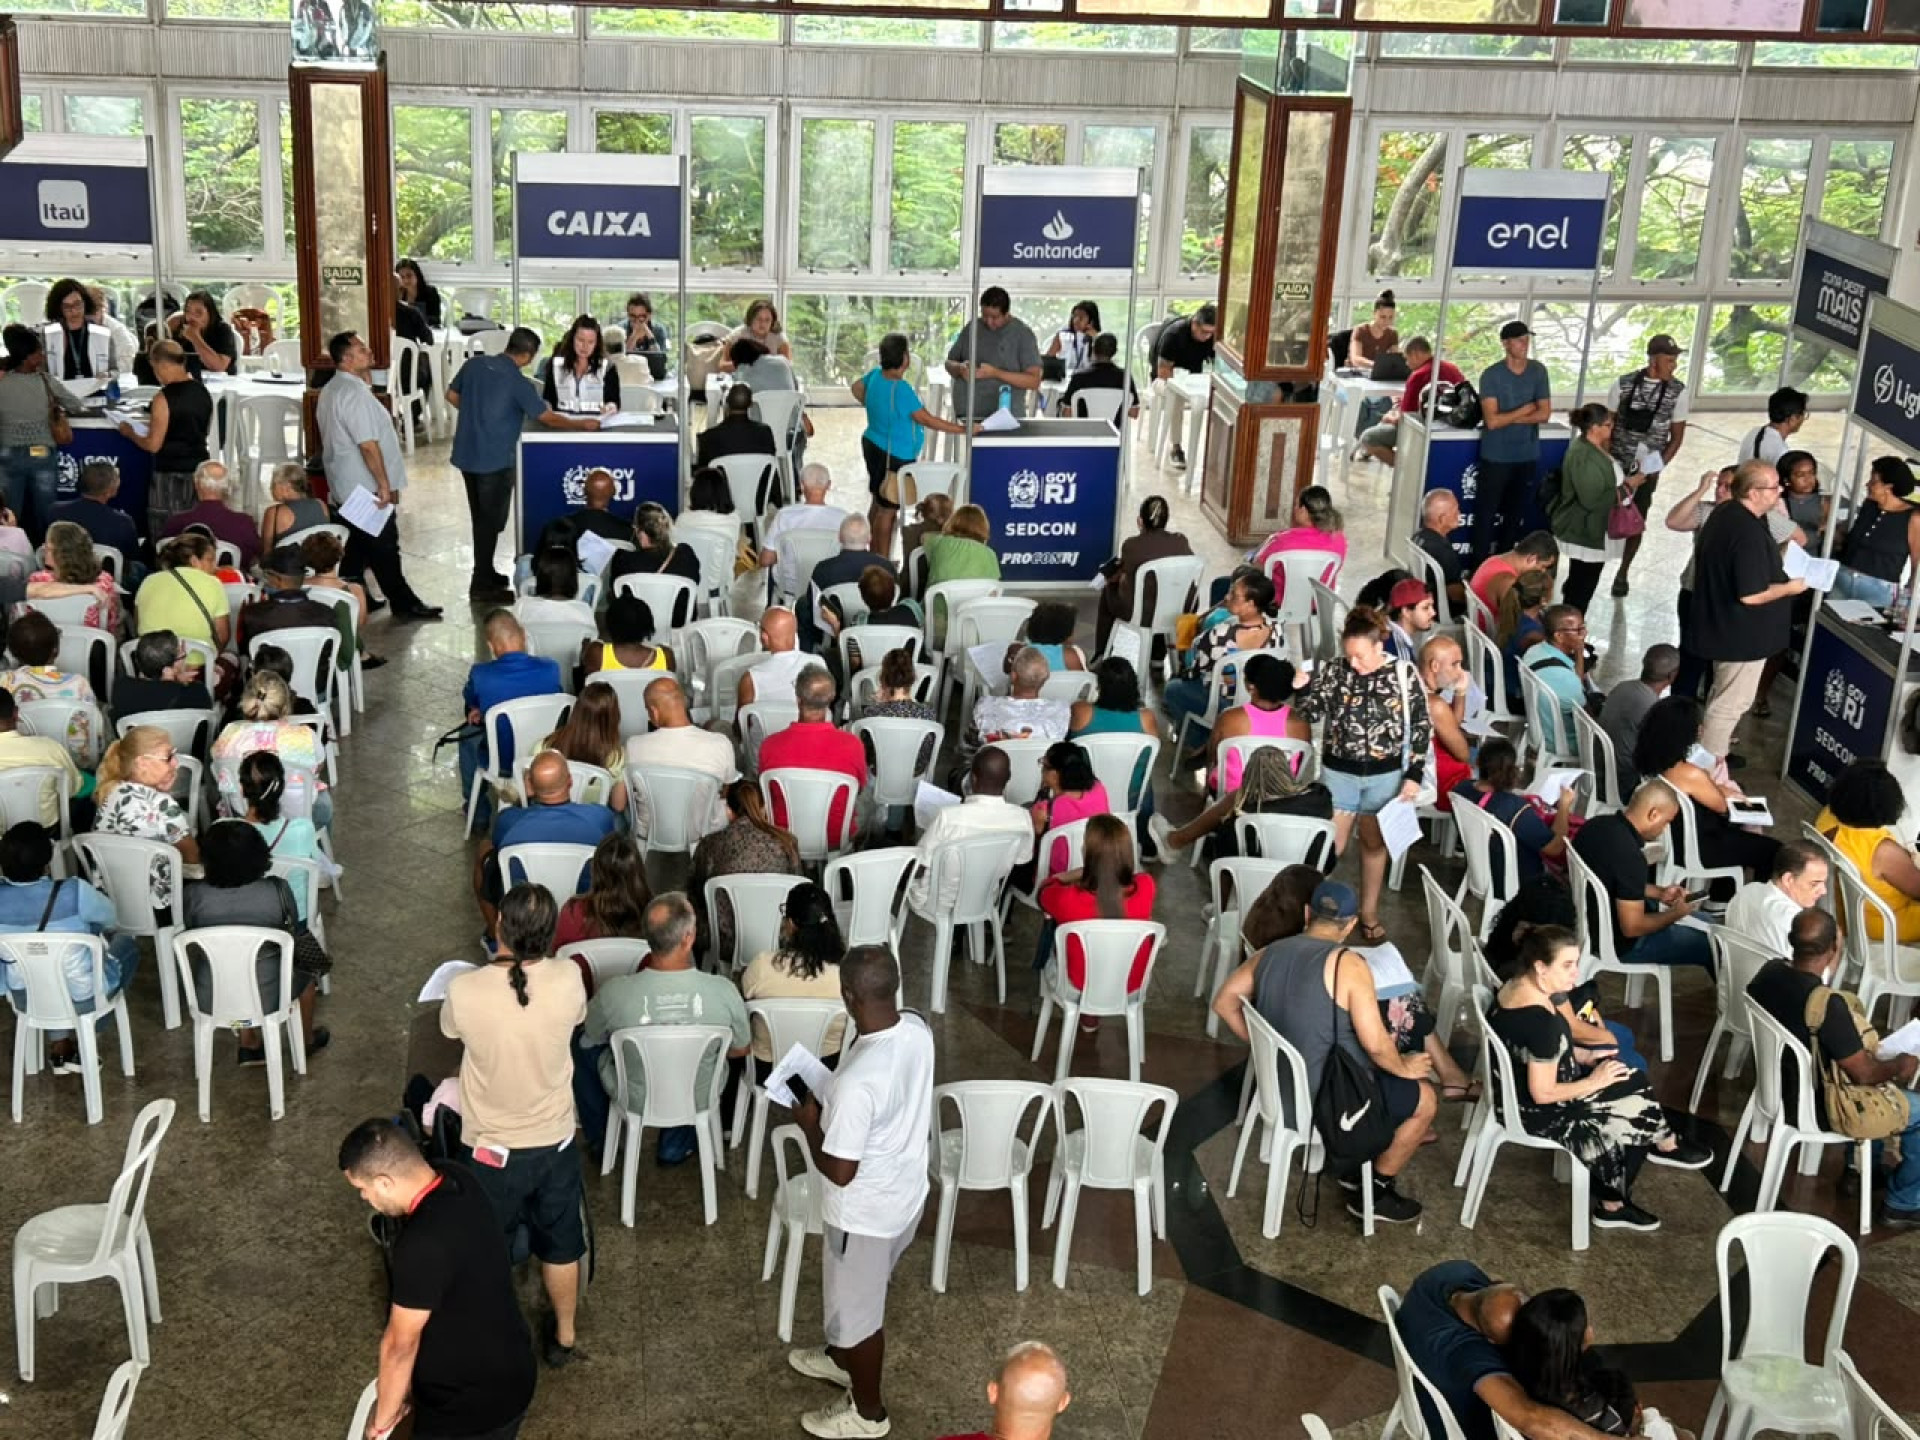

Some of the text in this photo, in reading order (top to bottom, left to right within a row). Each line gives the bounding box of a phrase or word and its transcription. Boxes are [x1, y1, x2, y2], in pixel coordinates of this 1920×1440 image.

[42, 203, 85, 220] Itaú
[547, 210, 652, 237] CAIXA
[1487, 216, 1569, 249] enel
[1013, 242, 1101, 259] Santander
[1817, 285, 1862, 325] MAIS
[1045, 472, 1077, 484] GOV
[1043, 482, 1077, 505] RJ
[1005, 522, 1077, 536] SEDCON
[1847, 683, 1867, 704] GOV
[1842, 695, 1865, 730] RJ
